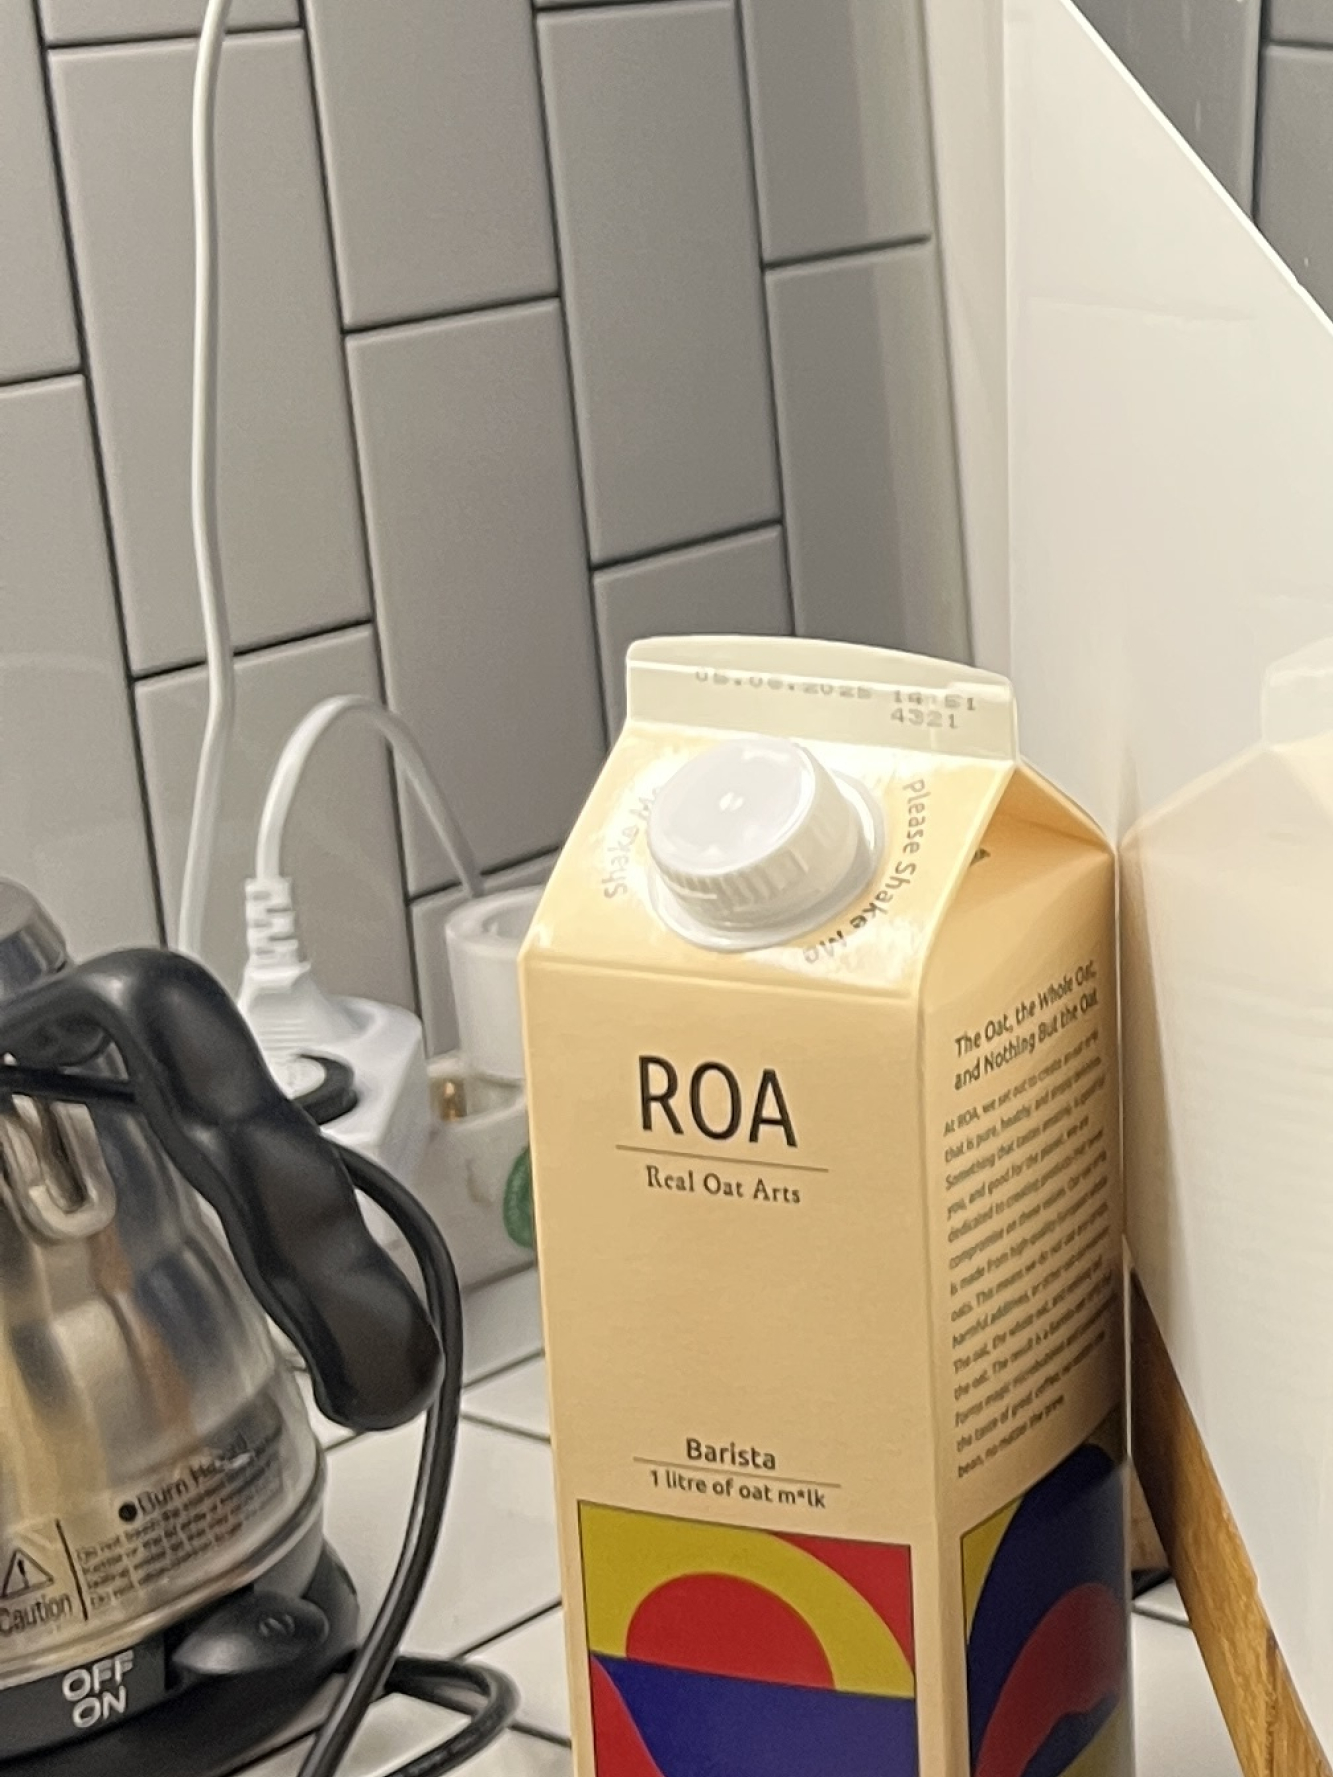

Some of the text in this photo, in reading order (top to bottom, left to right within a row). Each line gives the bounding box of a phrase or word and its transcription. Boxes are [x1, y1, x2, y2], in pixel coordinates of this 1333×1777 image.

[903, 778, 931, 854] Please
[849, 862, 917, 931] Shake
[954, 1030, 981, 1058] The
[1015, 1000, 1036, 1025] the
[1037, 974, 1074, 1010] Whole
[954, 1057, 981, 1091] and
[983, 1032, 1036, 1076] Nothing
[1037, 1014, 1059, 1043] But
[1060, 1002, 1078, 1029] the
[638, 1054, 798, 1149] ROA
[646, 1164, 801, 1204] Real Oat Arts
[685, 1436, 777, 1471] Barista
[650, 1469, 659, 1488] 1
[665, 1469, 707, 1494] litre
[712, 1477, 734, 1497] of
[739, 1484, 774, 1503] oat
[0, 1593, 73, 1637] Caution
[62, 1649, 134, 1702] OFF
[72, 1685, 127, 1728] ON
